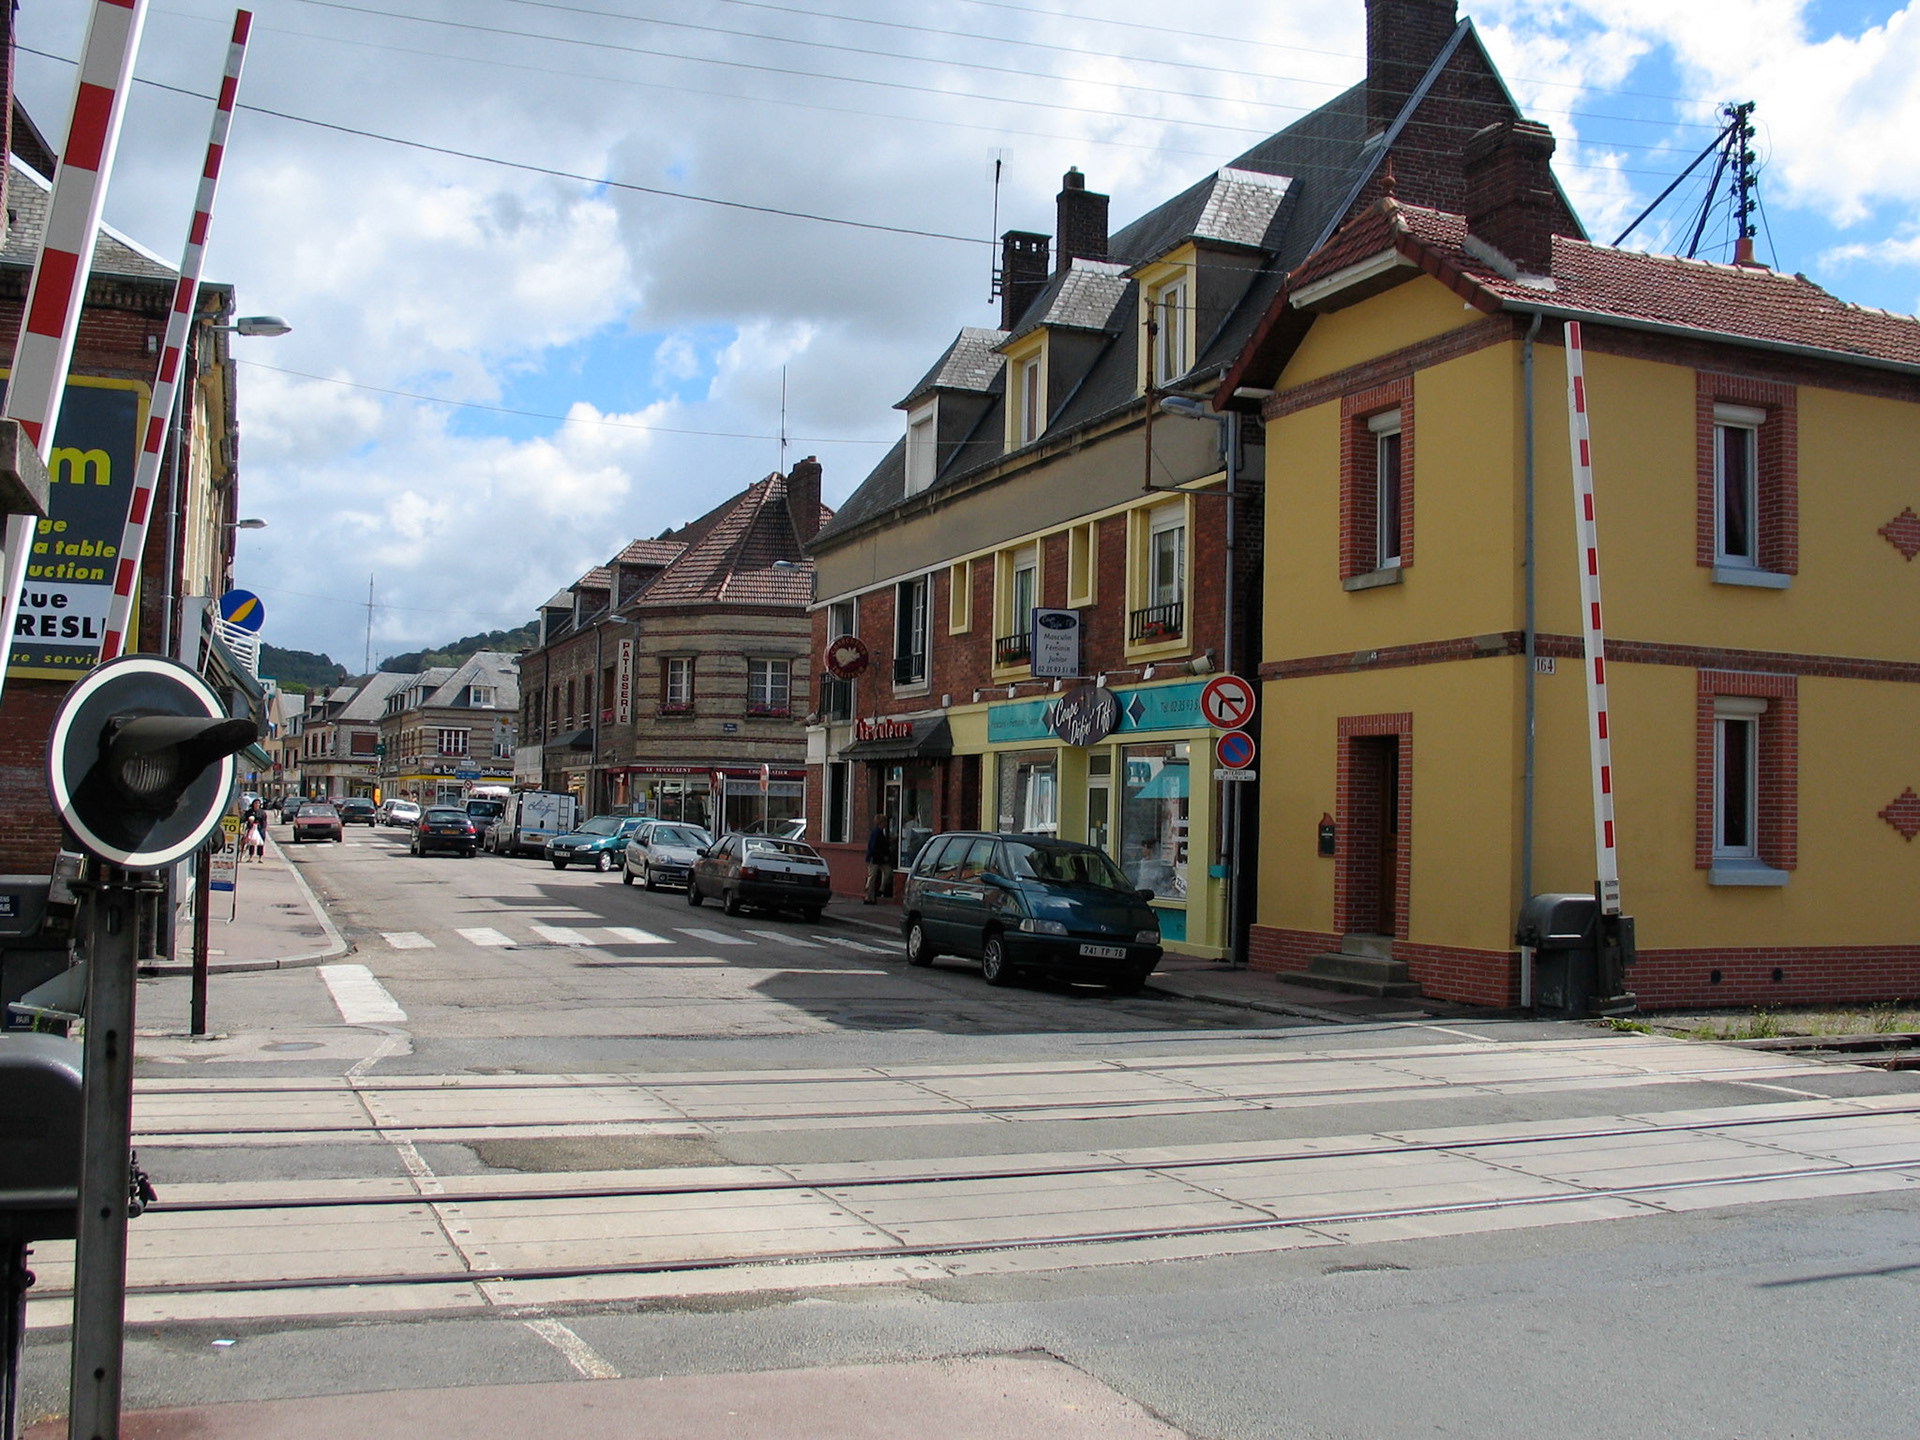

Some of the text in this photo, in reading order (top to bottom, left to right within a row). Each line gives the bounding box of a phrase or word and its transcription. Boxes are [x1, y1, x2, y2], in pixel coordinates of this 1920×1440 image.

[38, 518, 68, 535] ge
[33, 539, 117, 558] a table
[28, 561, 105, 580] uction
[14, 614, 106, 639] RESL
[1044, 633, 1072, 641] Masculin
[1045, 643, 1070, 651] Féminin
[1536, 659, 1553, 672] 164
[620, 642, 630, 723] PATISSERIE
